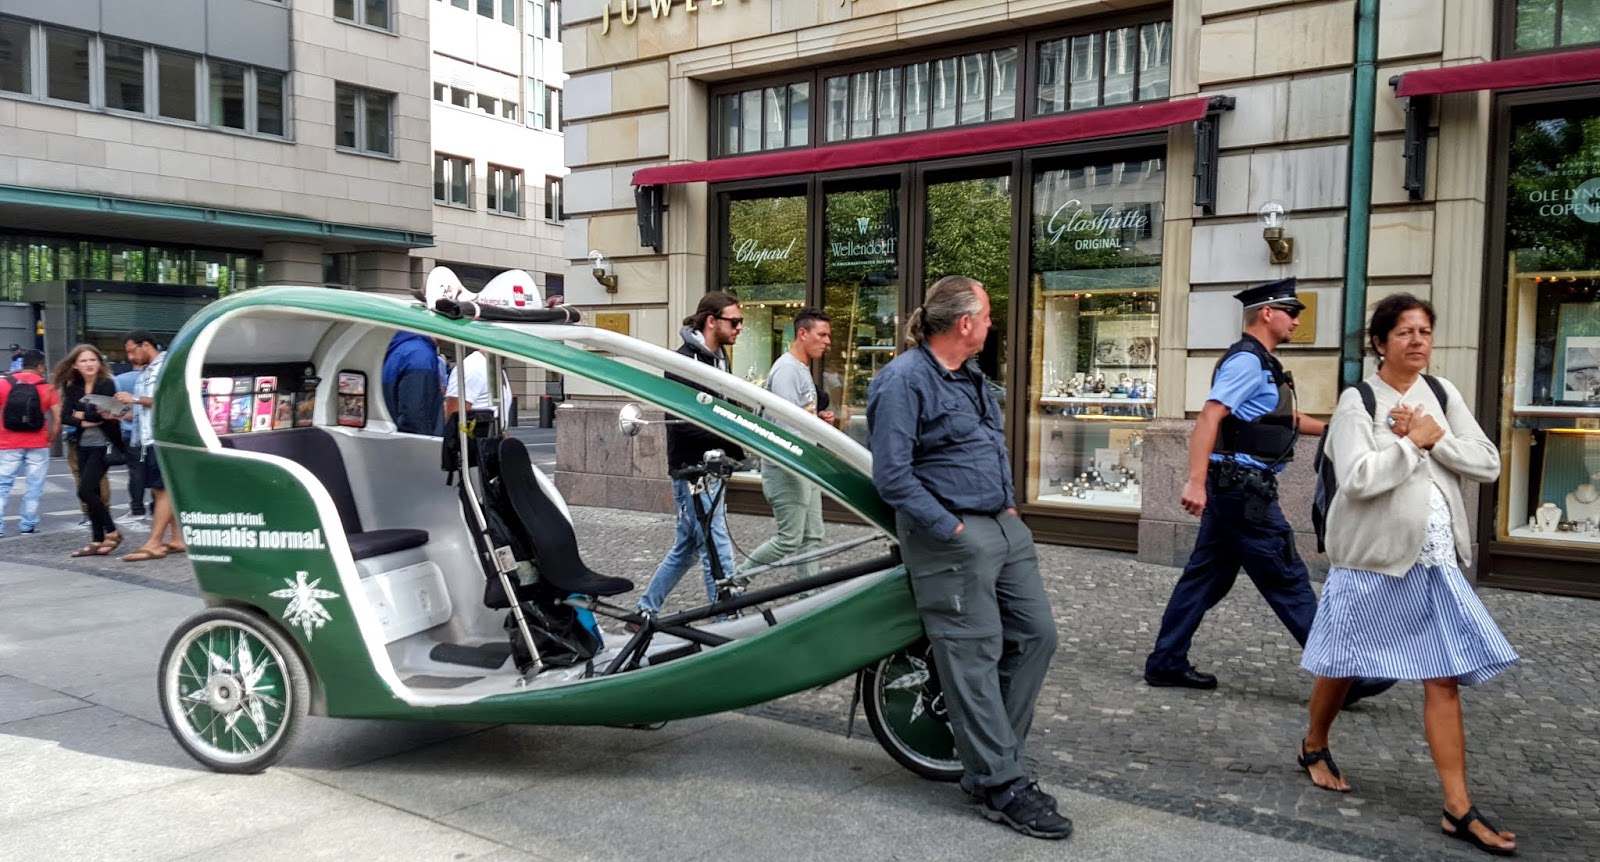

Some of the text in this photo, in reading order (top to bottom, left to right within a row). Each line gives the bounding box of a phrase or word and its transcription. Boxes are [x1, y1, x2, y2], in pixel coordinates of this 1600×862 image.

[1529, 189, 1559, 202] OLE
[1047, 199, 1149, 245] Glashütte
[732, 237, 797, 269] Chopard
[831, 237, 897, 257] Wellendorff
[1074, 238, 1121, 250] ORIGINAL
[180, 511, 267, 526] Schluss mit Krimi.
[182, 525, 326, 549] Cannabis normal.
